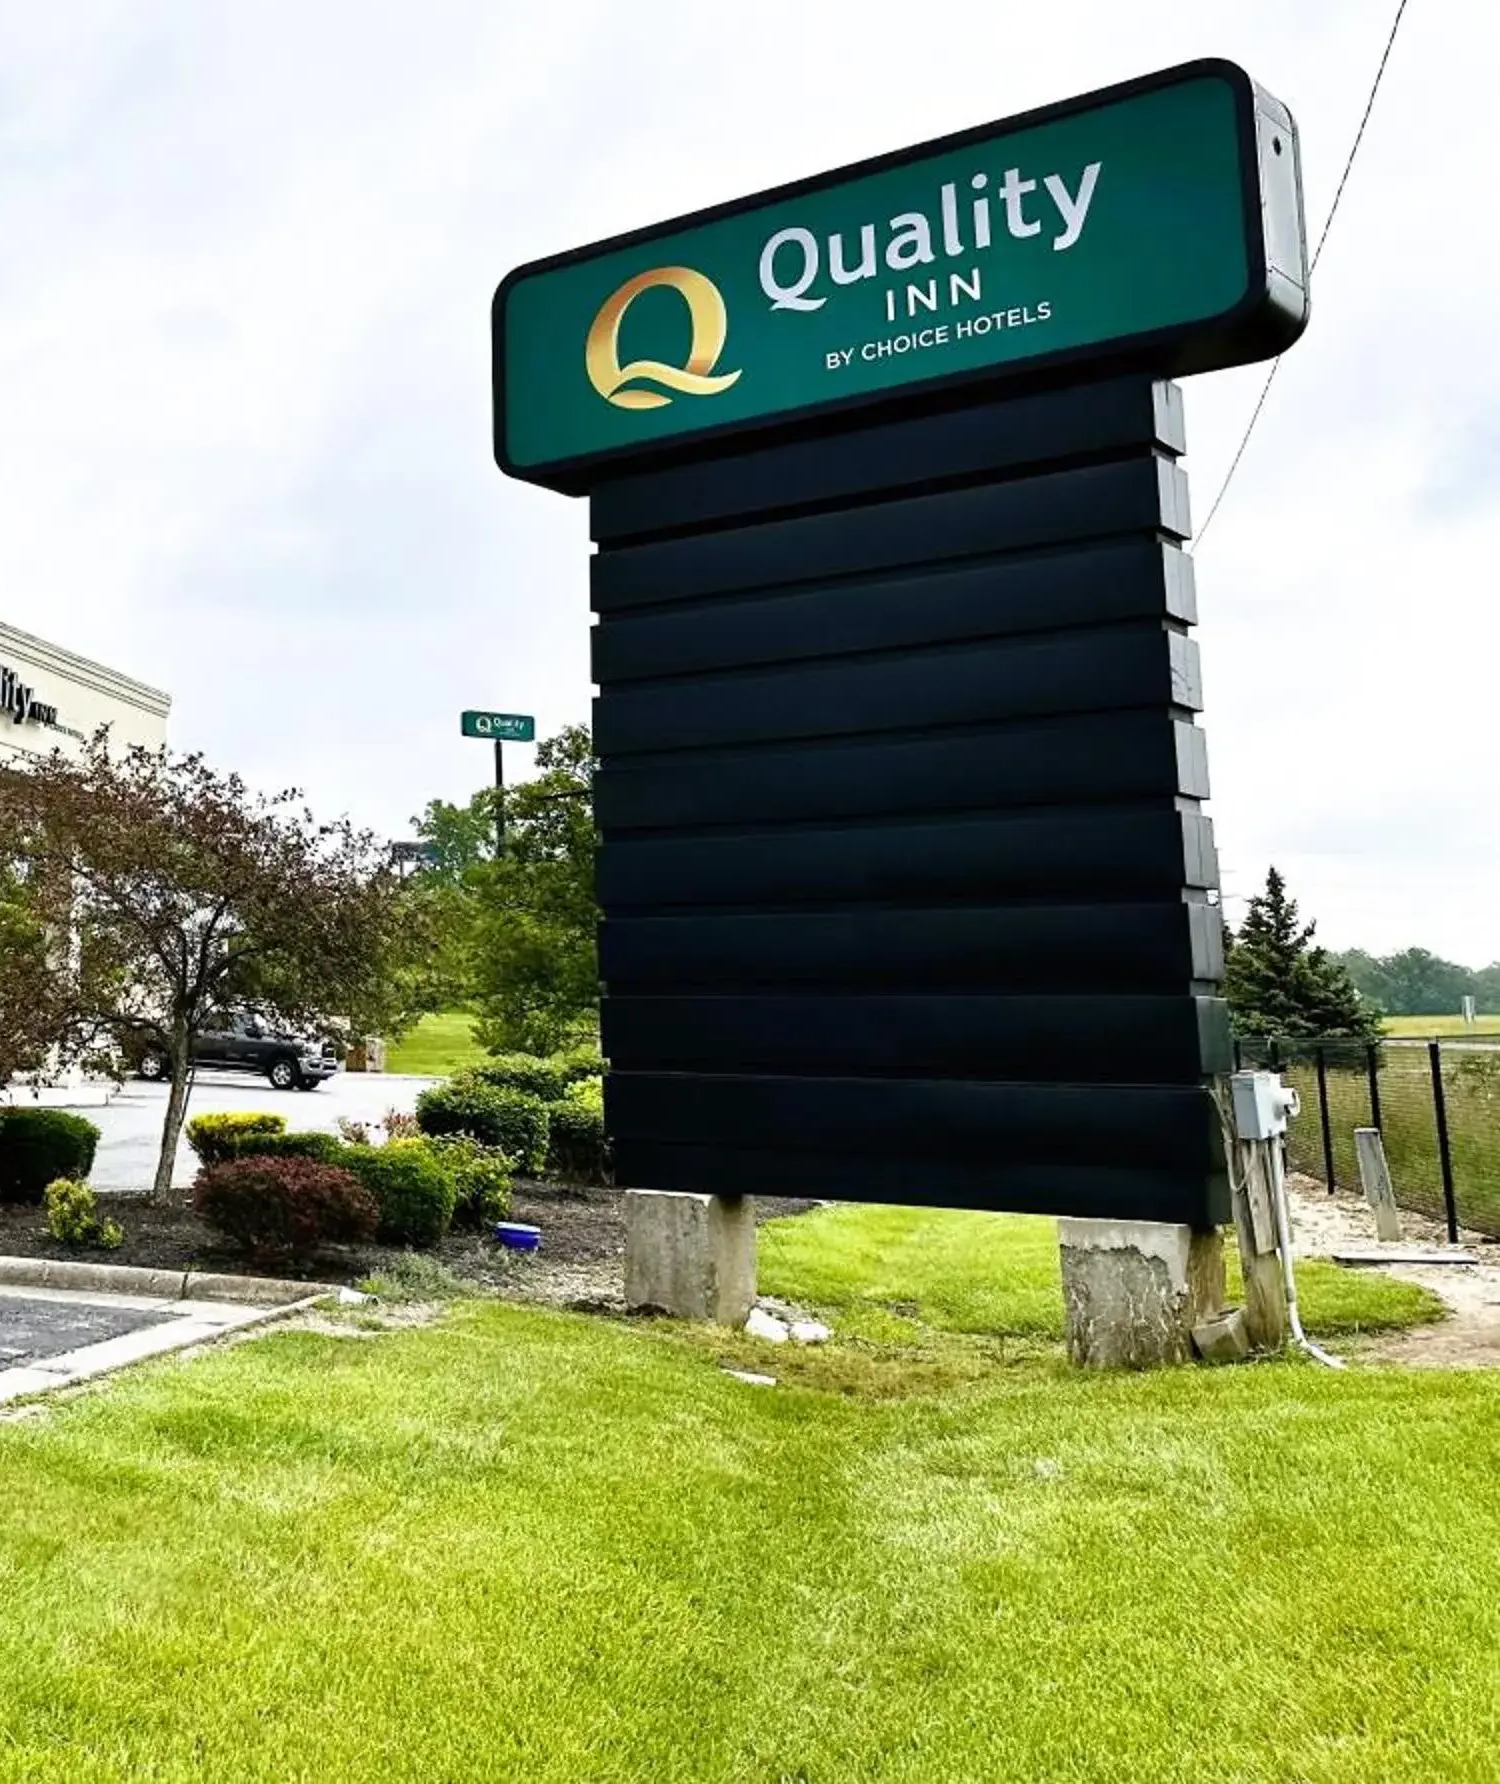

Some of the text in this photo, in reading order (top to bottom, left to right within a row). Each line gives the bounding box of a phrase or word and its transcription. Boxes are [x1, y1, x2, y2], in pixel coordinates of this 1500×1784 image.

[585, 162, 1102, 410] Q Quality
[886, 268, 982, 322] INN
[826, 301, 1052, 370] BY CHOICE HOTELS
